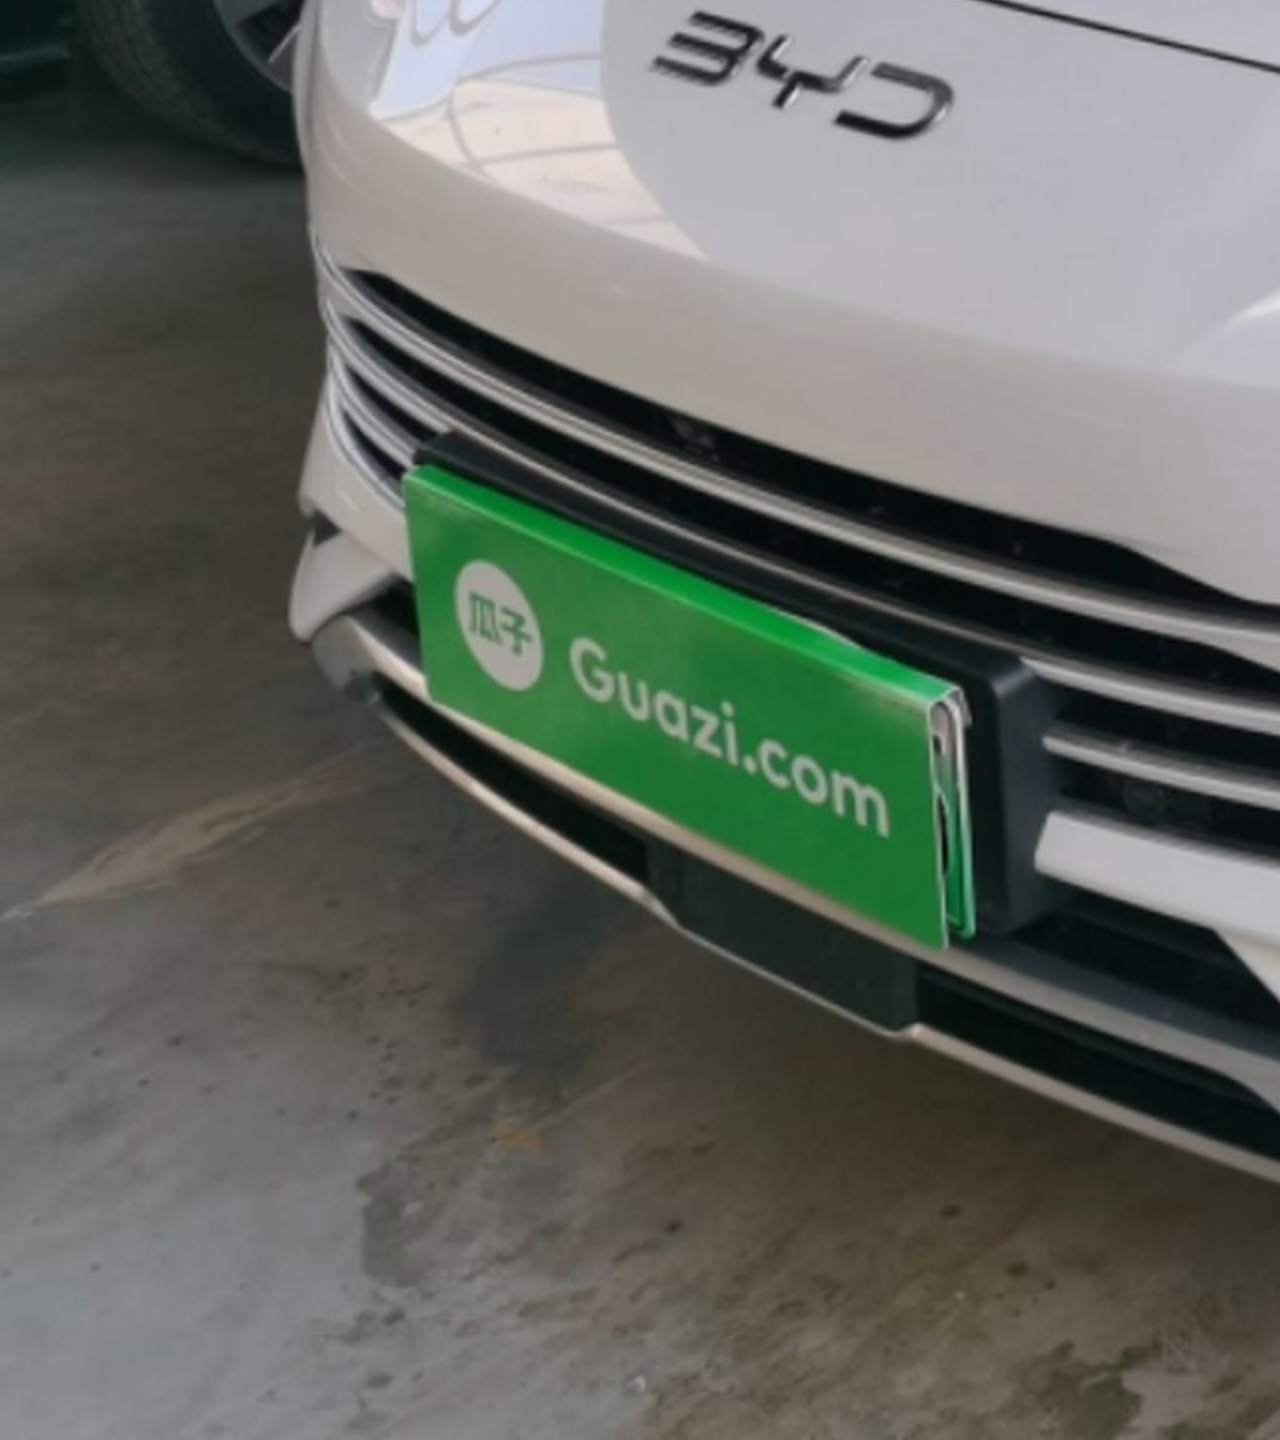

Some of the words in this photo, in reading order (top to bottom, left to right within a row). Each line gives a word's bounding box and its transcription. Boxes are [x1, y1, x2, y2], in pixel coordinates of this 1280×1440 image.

[651, 9, 955, 141] BYD
[467, 591, 533, 657] 瓜子
[568, 636, 891, 839] Guazi.com
